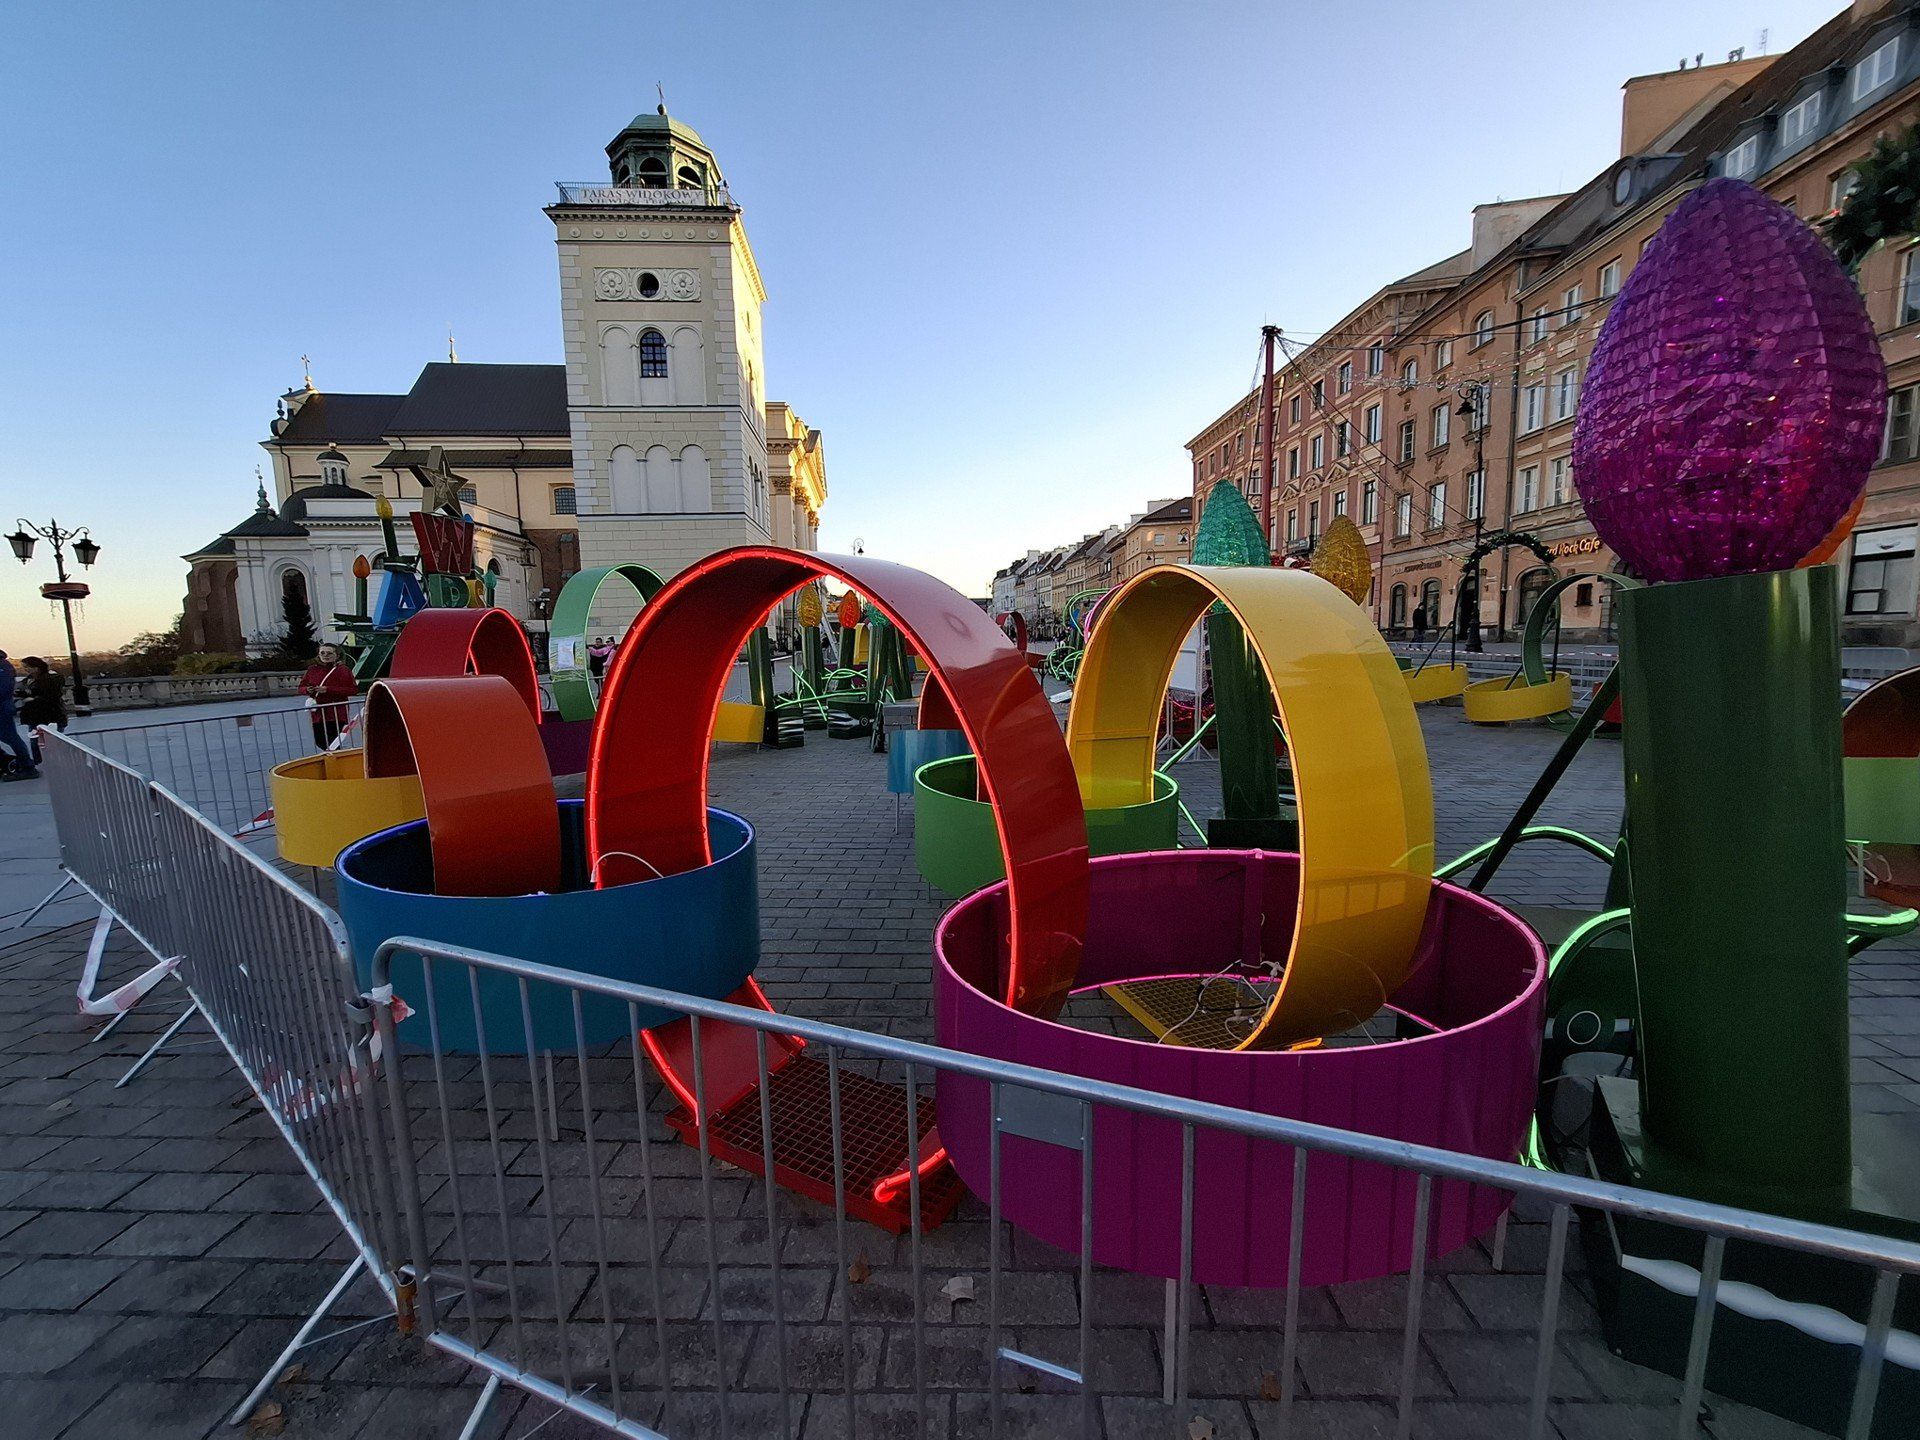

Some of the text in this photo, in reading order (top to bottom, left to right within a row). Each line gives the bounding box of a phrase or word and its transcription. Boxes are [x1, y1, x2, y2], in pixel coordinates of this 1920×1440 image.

[583, 188, 704, 199] TARAS WIDOKOWY
[410, 512, 474, 575] W
[1579, 536, 1600, 552] Cafe
[372, 569, 428, 630] A
